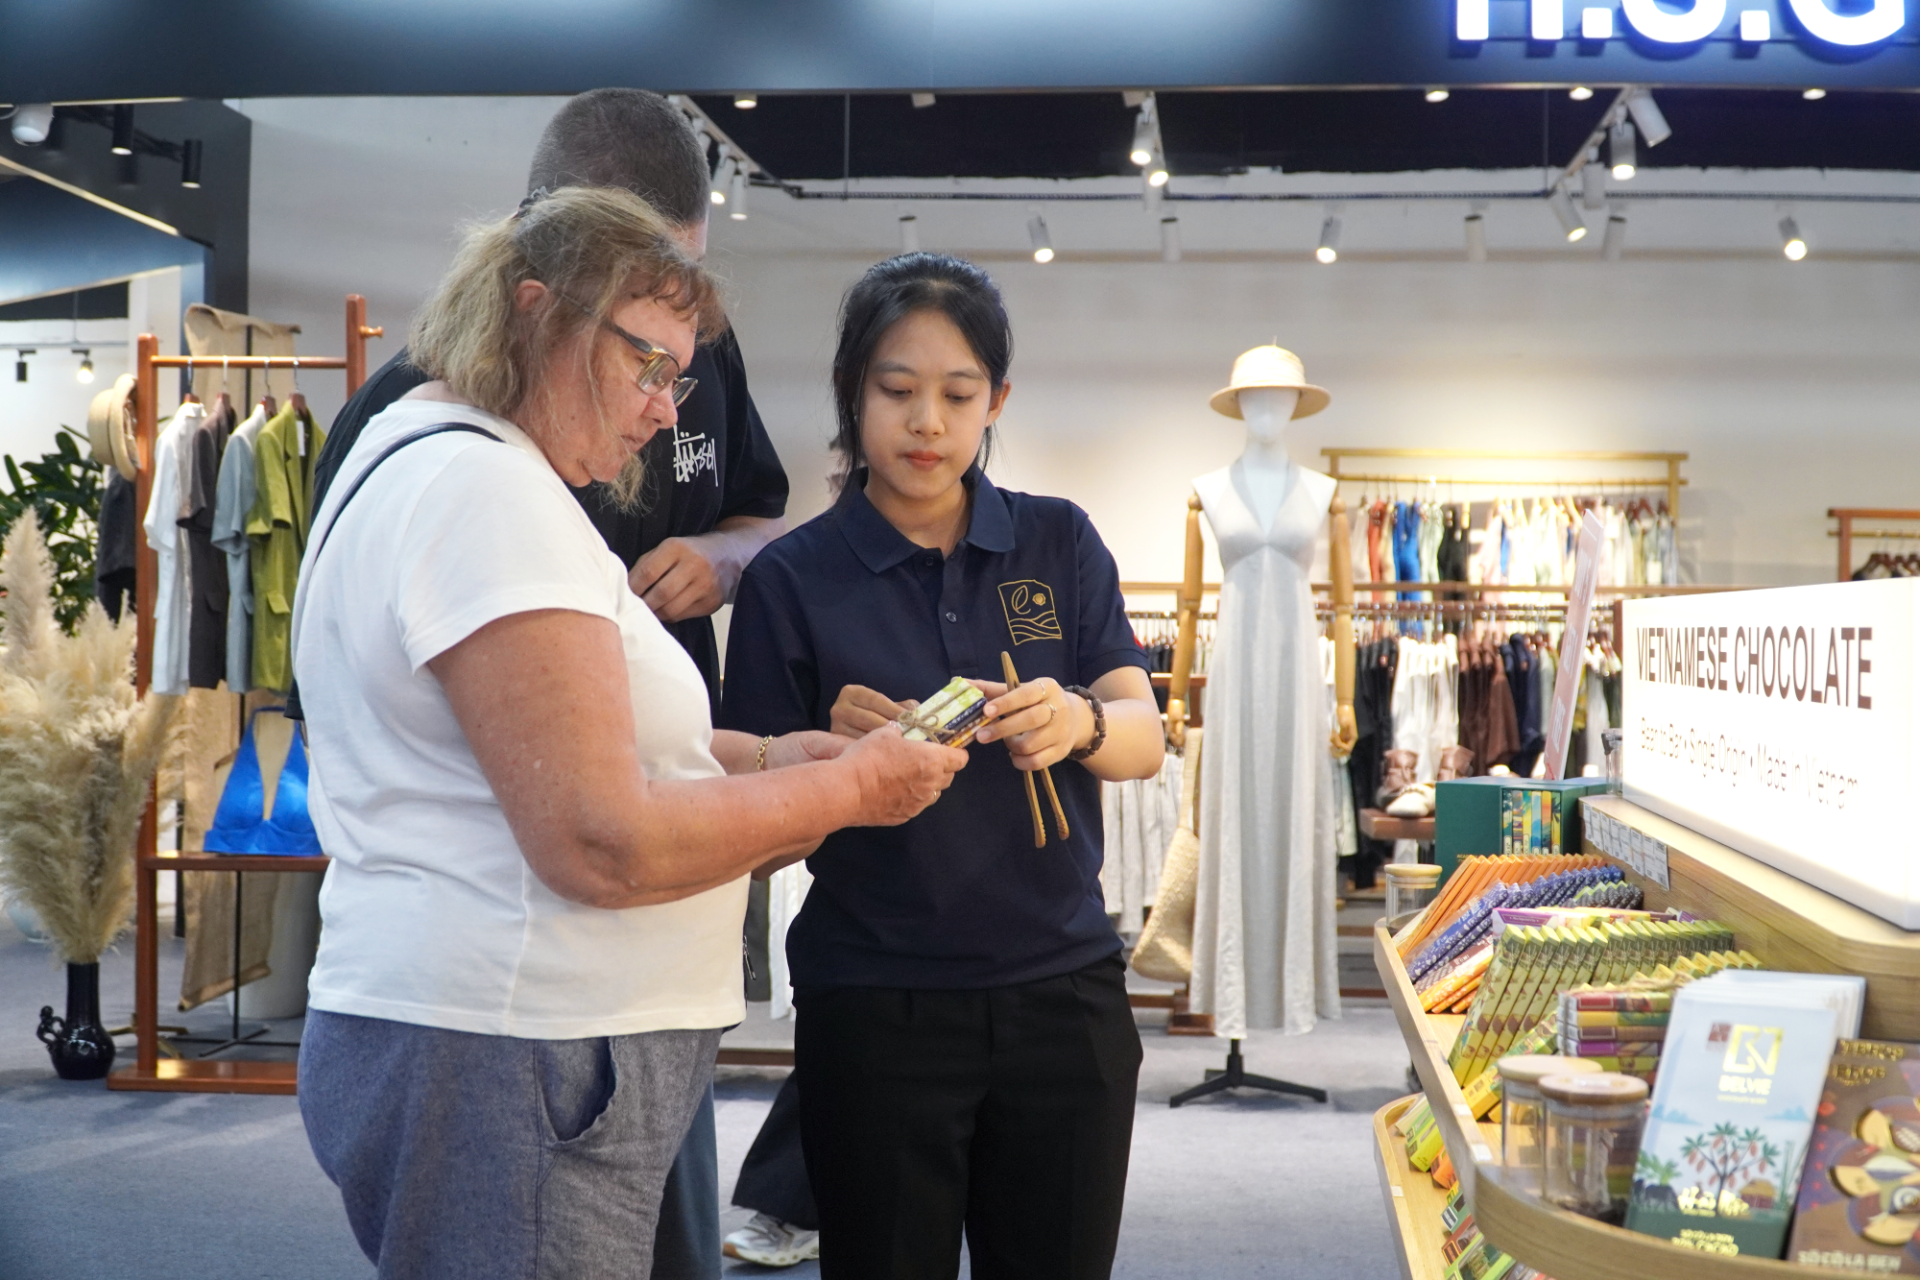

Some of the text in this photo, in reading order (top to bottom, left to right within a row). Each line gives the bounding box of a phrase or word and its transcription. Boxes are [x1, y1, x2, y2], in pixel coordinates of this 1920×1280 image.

[1636, 626, 1728, 692] VIETNAMESE
[1734, 625, 1873, 710] CHOCOLATE
[1640, 716, 1659, 752] Bean
[1668, 723, 1682, 759] Bar
[1689, 727, 1716, 779] Single
[1718, 734, 1747, 788] Origin
[1757, 742, 1788, 792] Made
[1791, 750, 1802, 794] in
[1805, 753, 1860, 811] Vietnam
